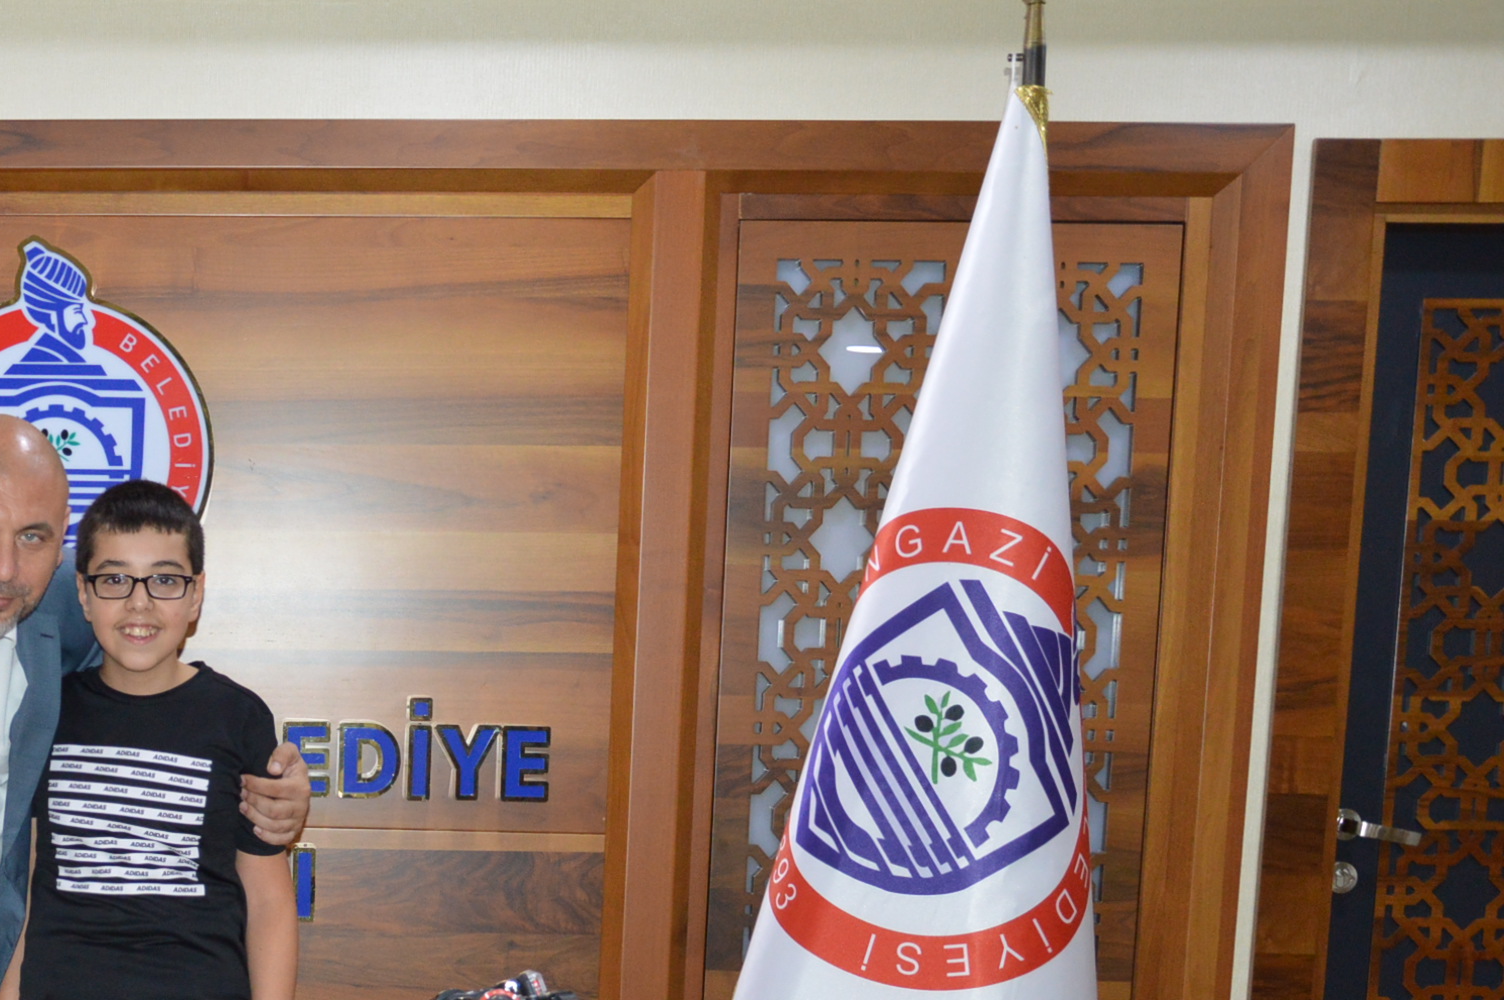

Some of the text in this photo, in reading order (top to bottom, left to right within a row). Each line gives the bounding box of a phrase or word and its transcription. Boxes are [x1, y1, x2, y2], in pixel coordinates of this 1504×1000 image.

[116, 749, 140, 758] ADIDAS
[153, 754, 178, 763] ADIDAS
[131, 770, 156, 779] ADIDAS
[168, 776, 194, 785] ADIDAS
[104, 786, 129, 794] ADIDAS
[141, 790, 166, 799] ADIDAS
[179, 795, 204, 804] ADIDAS
[120, 807, 145, 815] ADIDAS
[157, 812, 183, 820] ADIDAS
[70, 818, 94, 826] ADIDAS
[144, 831, 169, 840] ADIDAS
